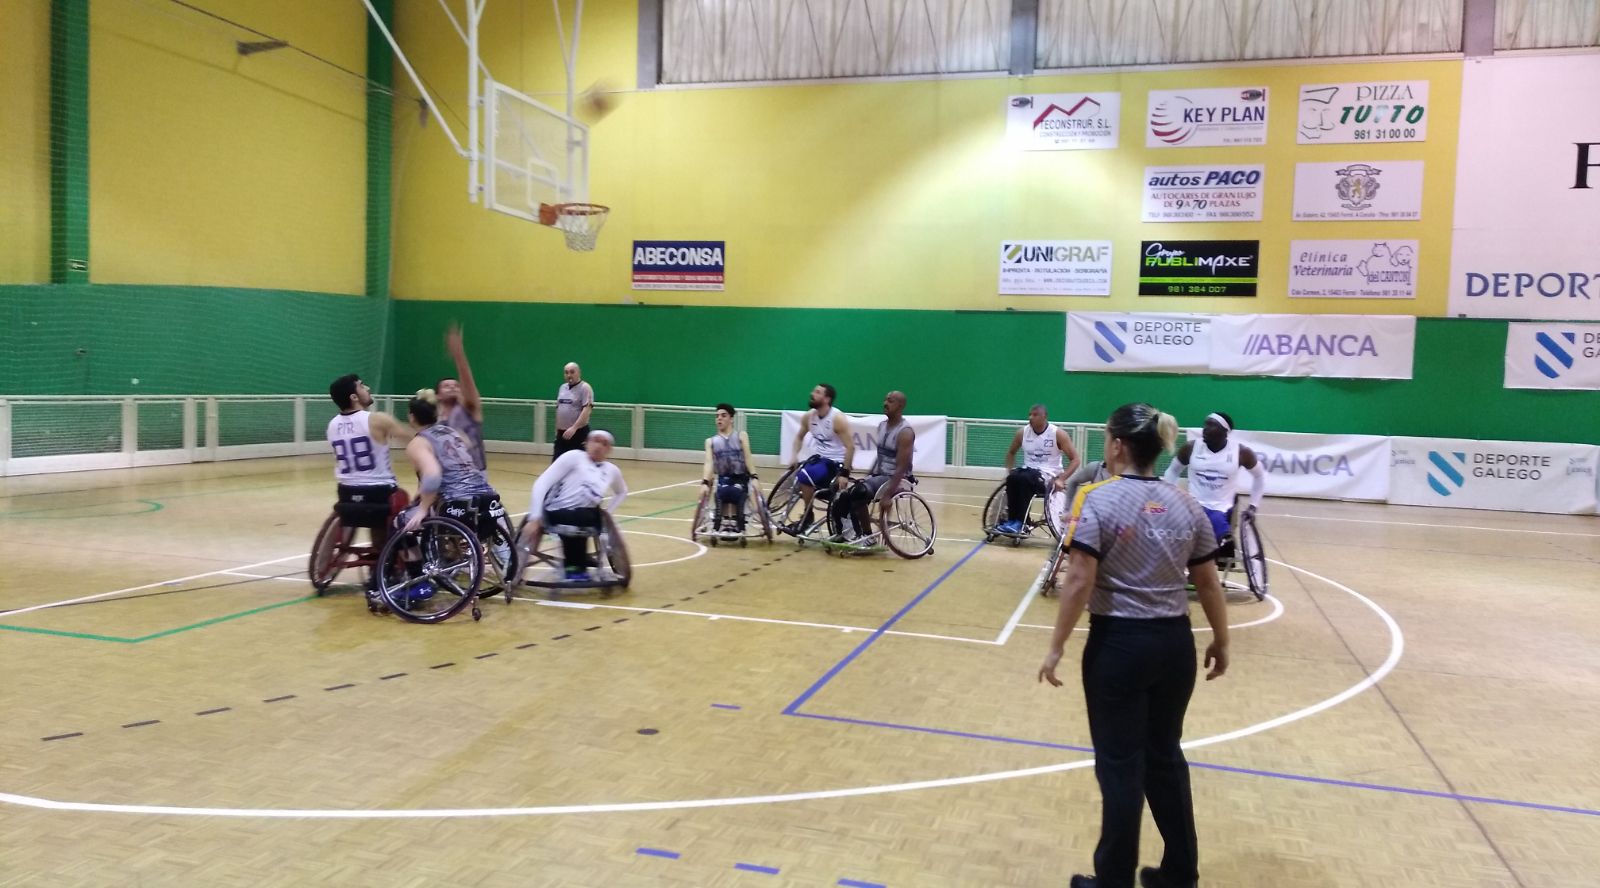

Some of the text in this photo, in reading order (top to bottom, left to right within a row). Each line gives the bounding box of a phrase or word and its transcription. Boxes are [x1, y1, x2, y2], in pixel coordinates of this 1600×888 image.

[1356, 85, 1413, 101] PIZZA
[1184, 106, 1265, 123] KEY PLAN
[1389, 129, 1400, 139] 00
[1404, 128, 1416, 138] 00
[1148, 170, 1261, 186] autos PACO
[1151, 192, 1199, 200] AUTOCARES
[1164, 200, 1173, 208] DE
[1176, 200, 1184, 210] 9
[1192, 200, 1207, 210] 70
[633, 247, 723, 266] ABECONSA
[1024, 246, 1109, 262] UNIGRAF
[1293, 264, 1353, 276] Veterinaria
[1134, 322, 1201, 333] DEPORTE
[1133, 335, 1194, 346] GALEGO
[1044, 439, 1054, 448] 23
[1255, 451, 1354, 477] BANCA
[1473, 453, 1551, 467] DEPORTE
[1472, 467, 1542, 481] GALEGO
